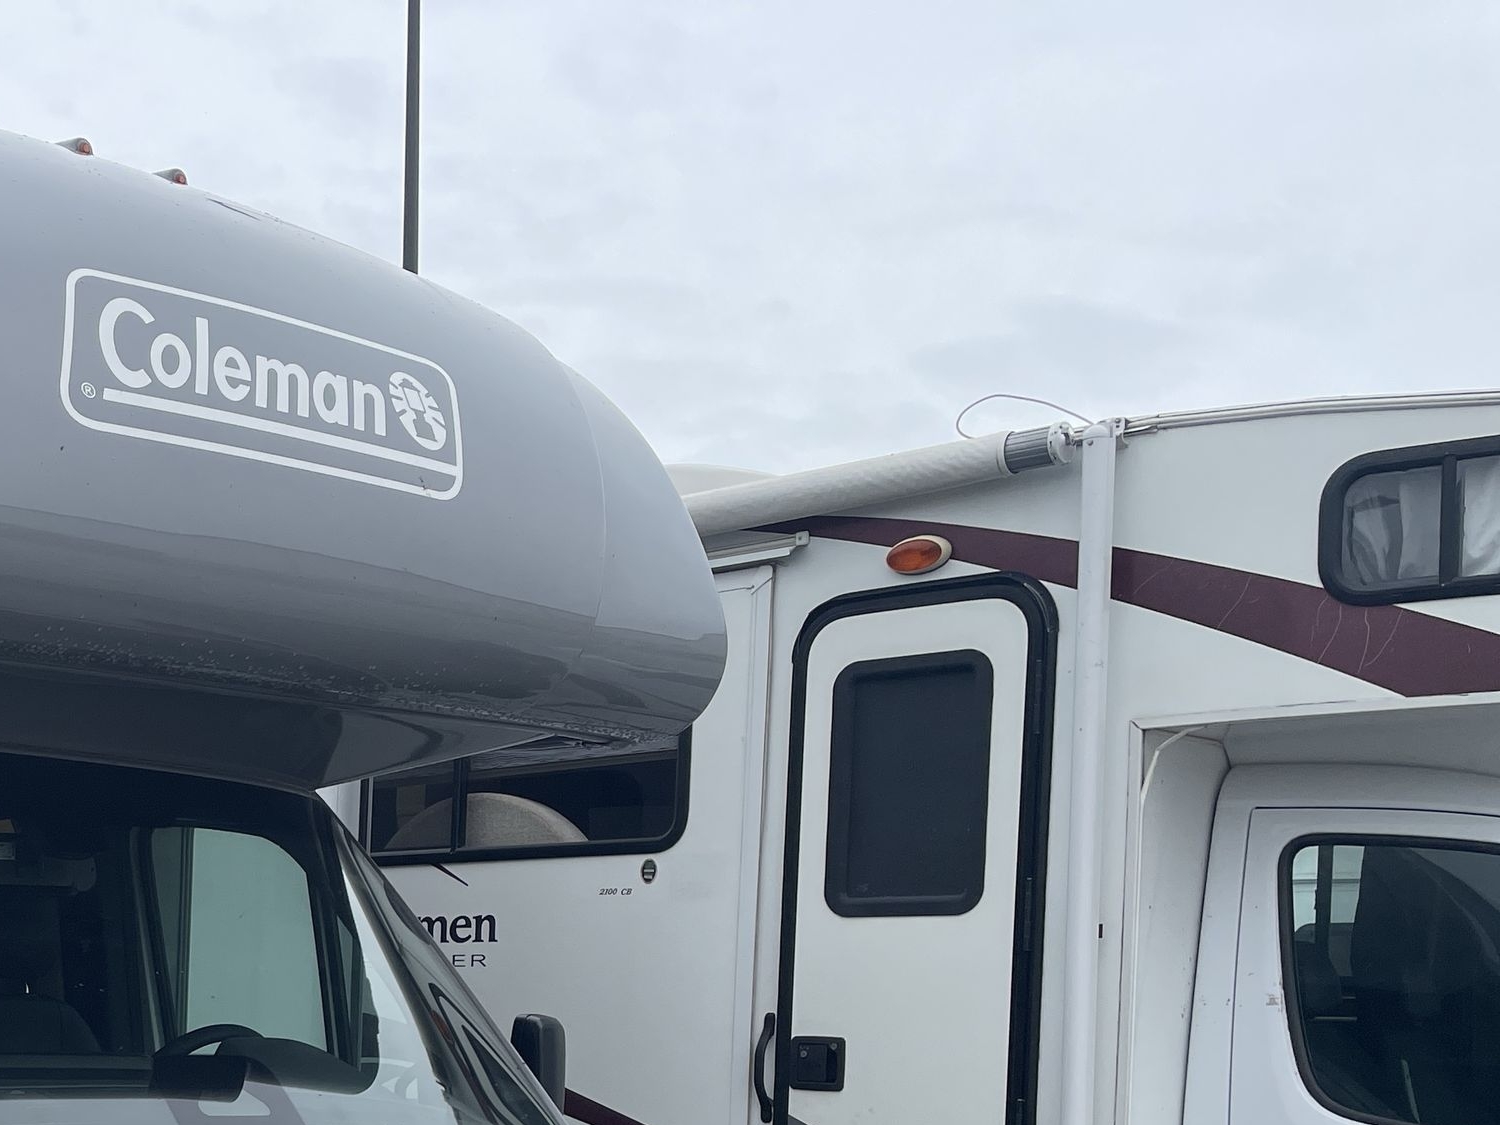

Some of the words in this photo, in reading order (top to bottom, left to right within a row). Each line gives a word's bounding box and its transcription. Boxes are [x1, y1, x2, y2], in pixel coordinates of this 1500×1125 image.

[98, 297, 387, 437] Coleman
[598, 887, 618, 896] 2100
[417, 914, 498, 944] men
[452, 953, 487, 968] ER
